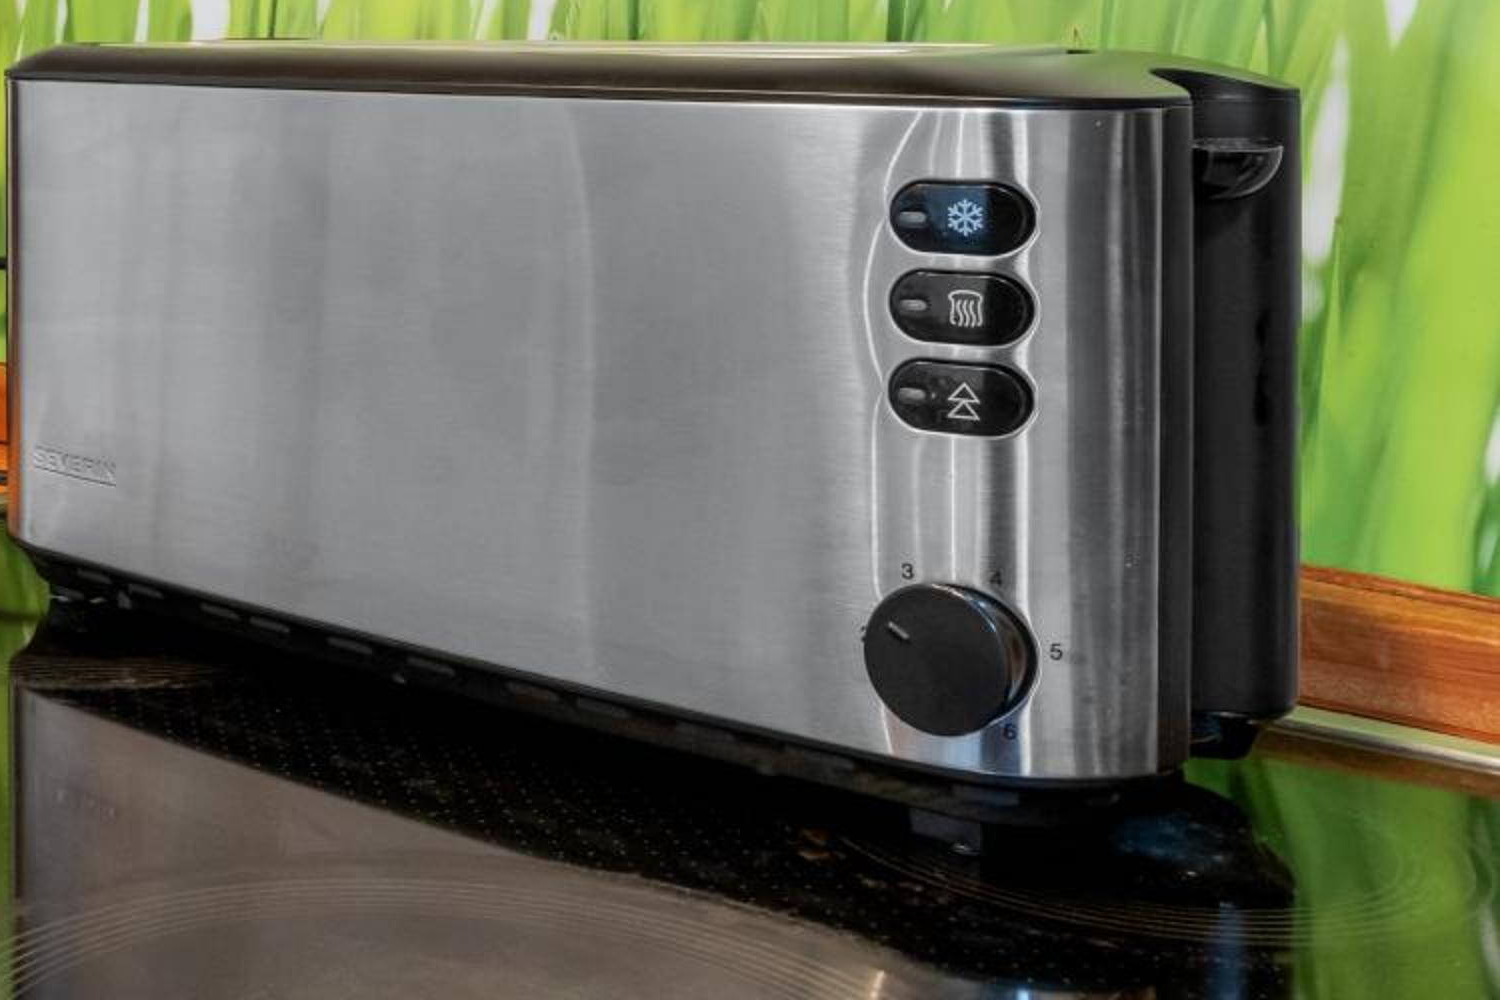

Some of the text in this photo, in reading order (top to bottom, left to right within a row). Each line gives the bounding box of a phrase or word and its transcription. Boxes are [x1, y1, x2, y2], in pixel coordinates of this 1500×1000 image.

[901, 563, 914, 580] 3
[990, 571, 1003, 585] 4
[1049, 643, 1064, 661] 5
[1003, 722, 1018, 740] 6
